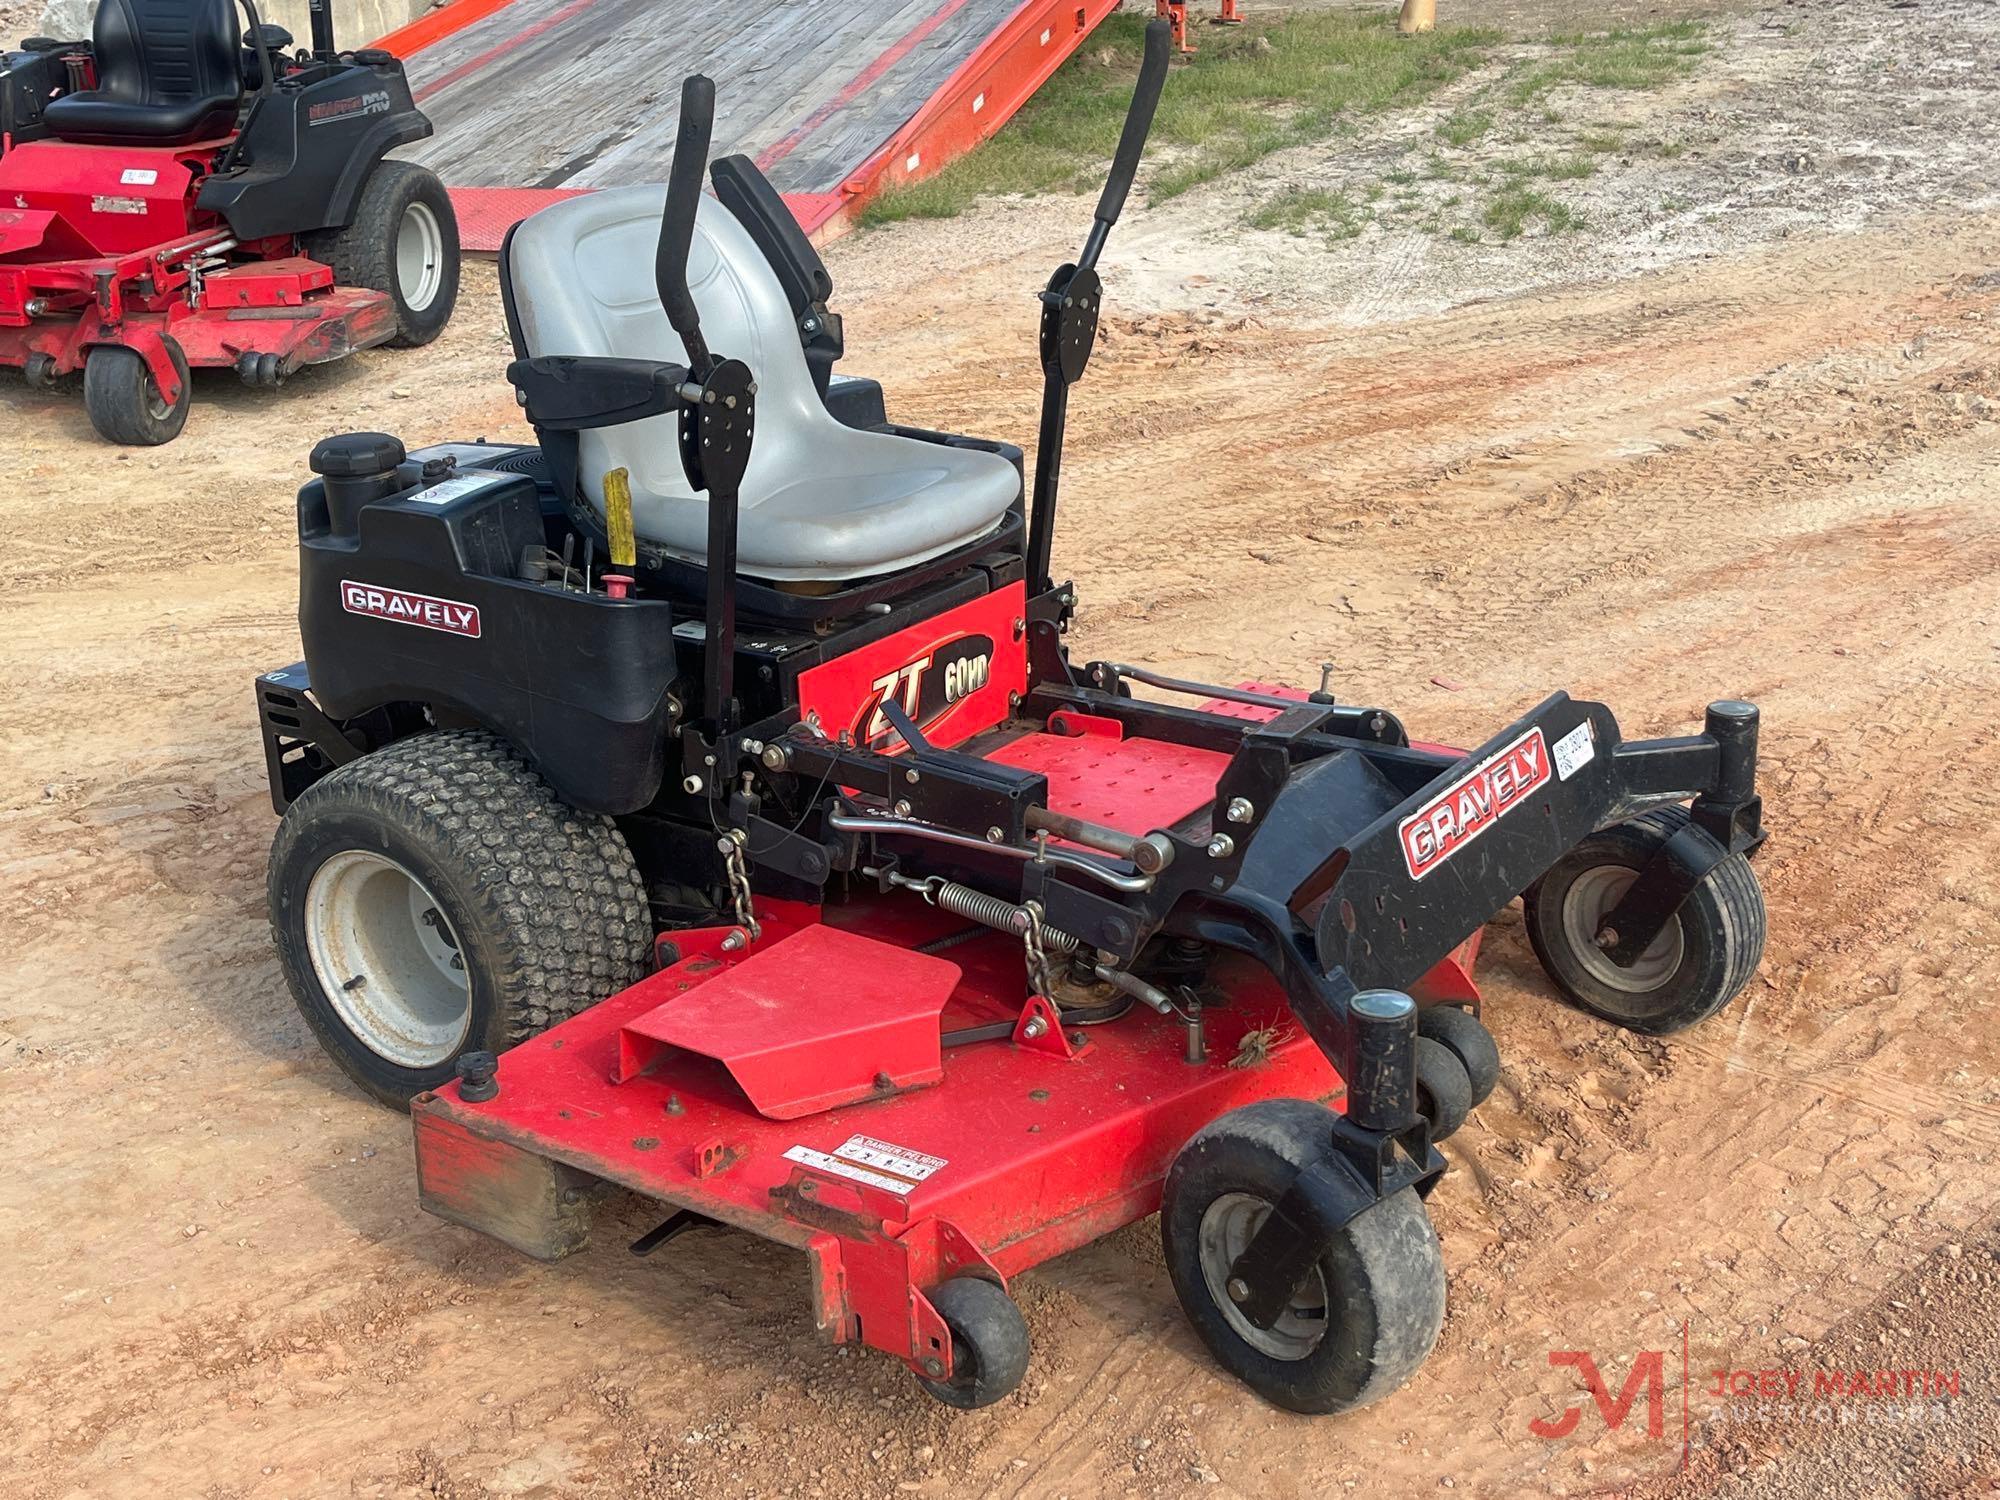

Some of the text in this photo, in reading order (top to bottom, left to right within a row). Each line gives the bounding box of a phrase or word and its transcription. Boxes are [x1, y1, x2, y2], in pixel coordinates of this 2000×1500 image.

[363, 90, 390, 114] PRO
[347, 587, 474, 630] GRAVELY
[869, 654, 988, 737] ZT 60HD
[1408, 738, 1542, 866] GRAVELY
